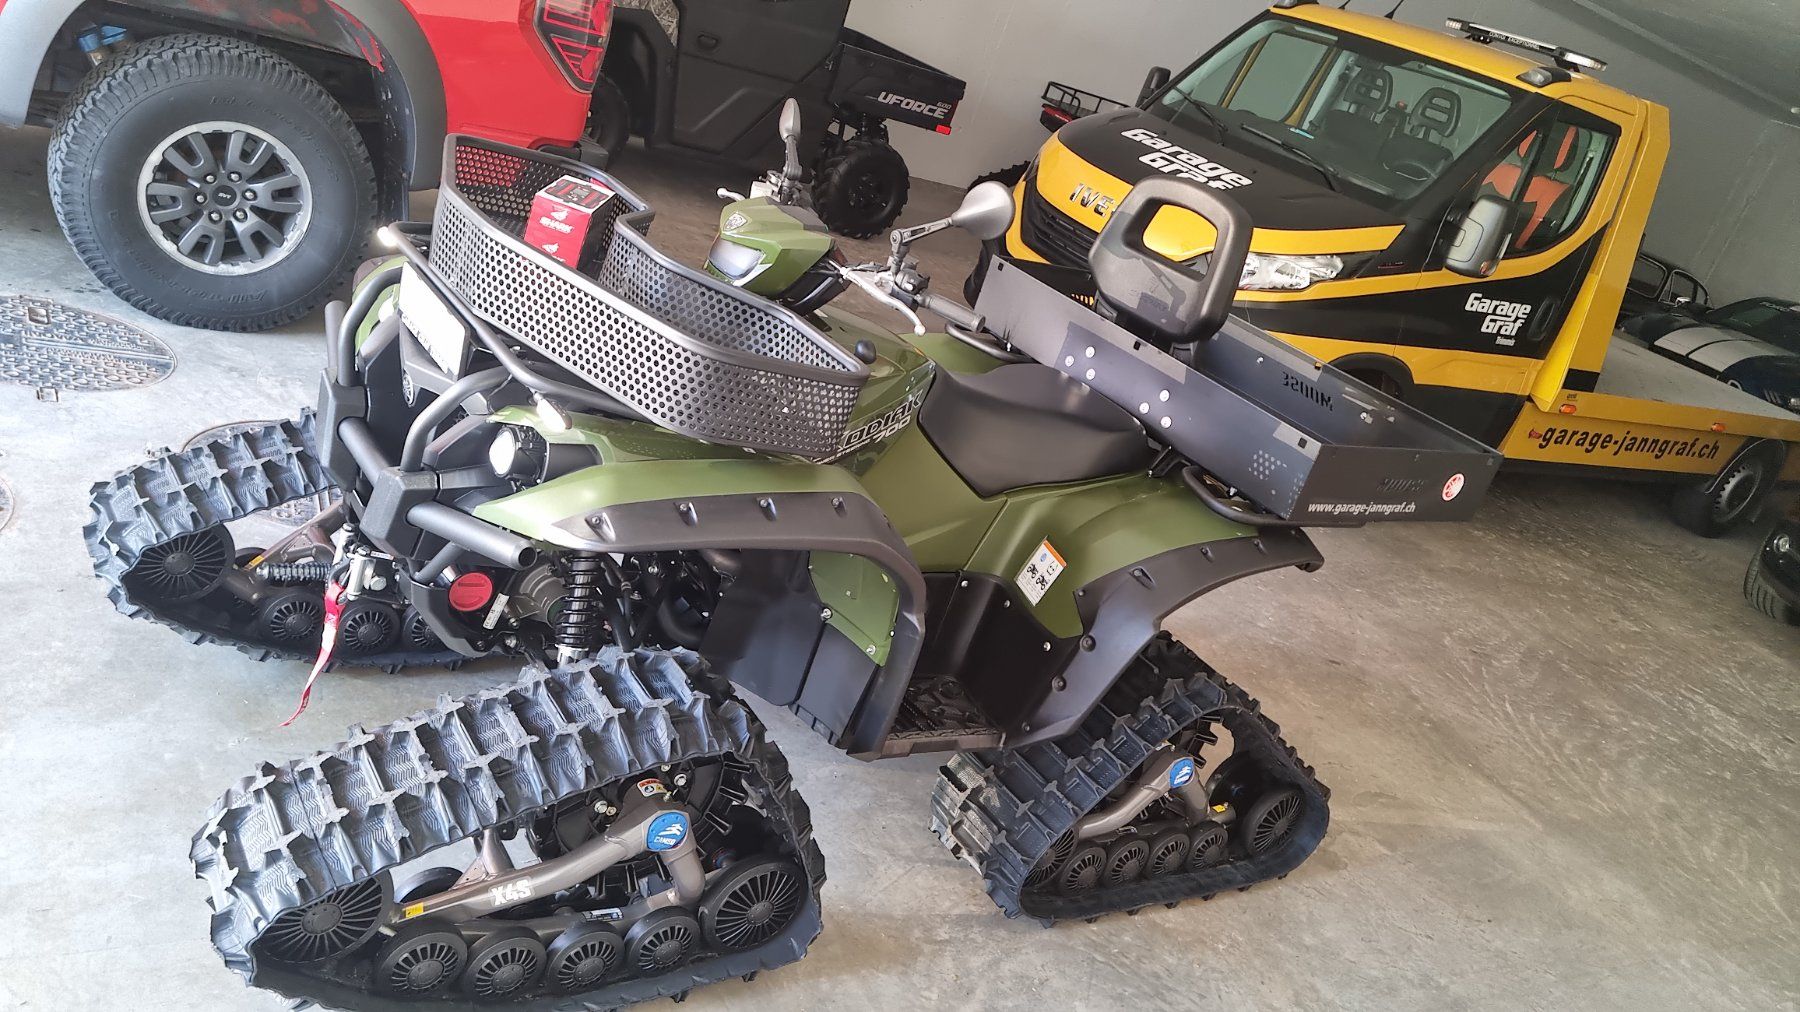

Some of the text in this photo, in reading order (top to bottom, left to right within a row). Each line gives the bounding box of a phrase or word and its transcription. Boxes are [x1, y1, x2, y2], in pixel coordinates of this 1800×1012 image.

[878, 91, 949, 119] UFORCE
[1121, 128, 1253, 187] Garage
[1069, 182, 1116, 217] IVE
[1465, 292, 1532, 322] Garage
[1480, 315, 1526, 336] Graf
[872, 415, 911, 443] 700
[1538, 427, 1720, 461] garage-janngraf.ch
[1307, 502, 1417, 516] www.garage-janngraf.ch
[490, 879, 532, 906] X4S
